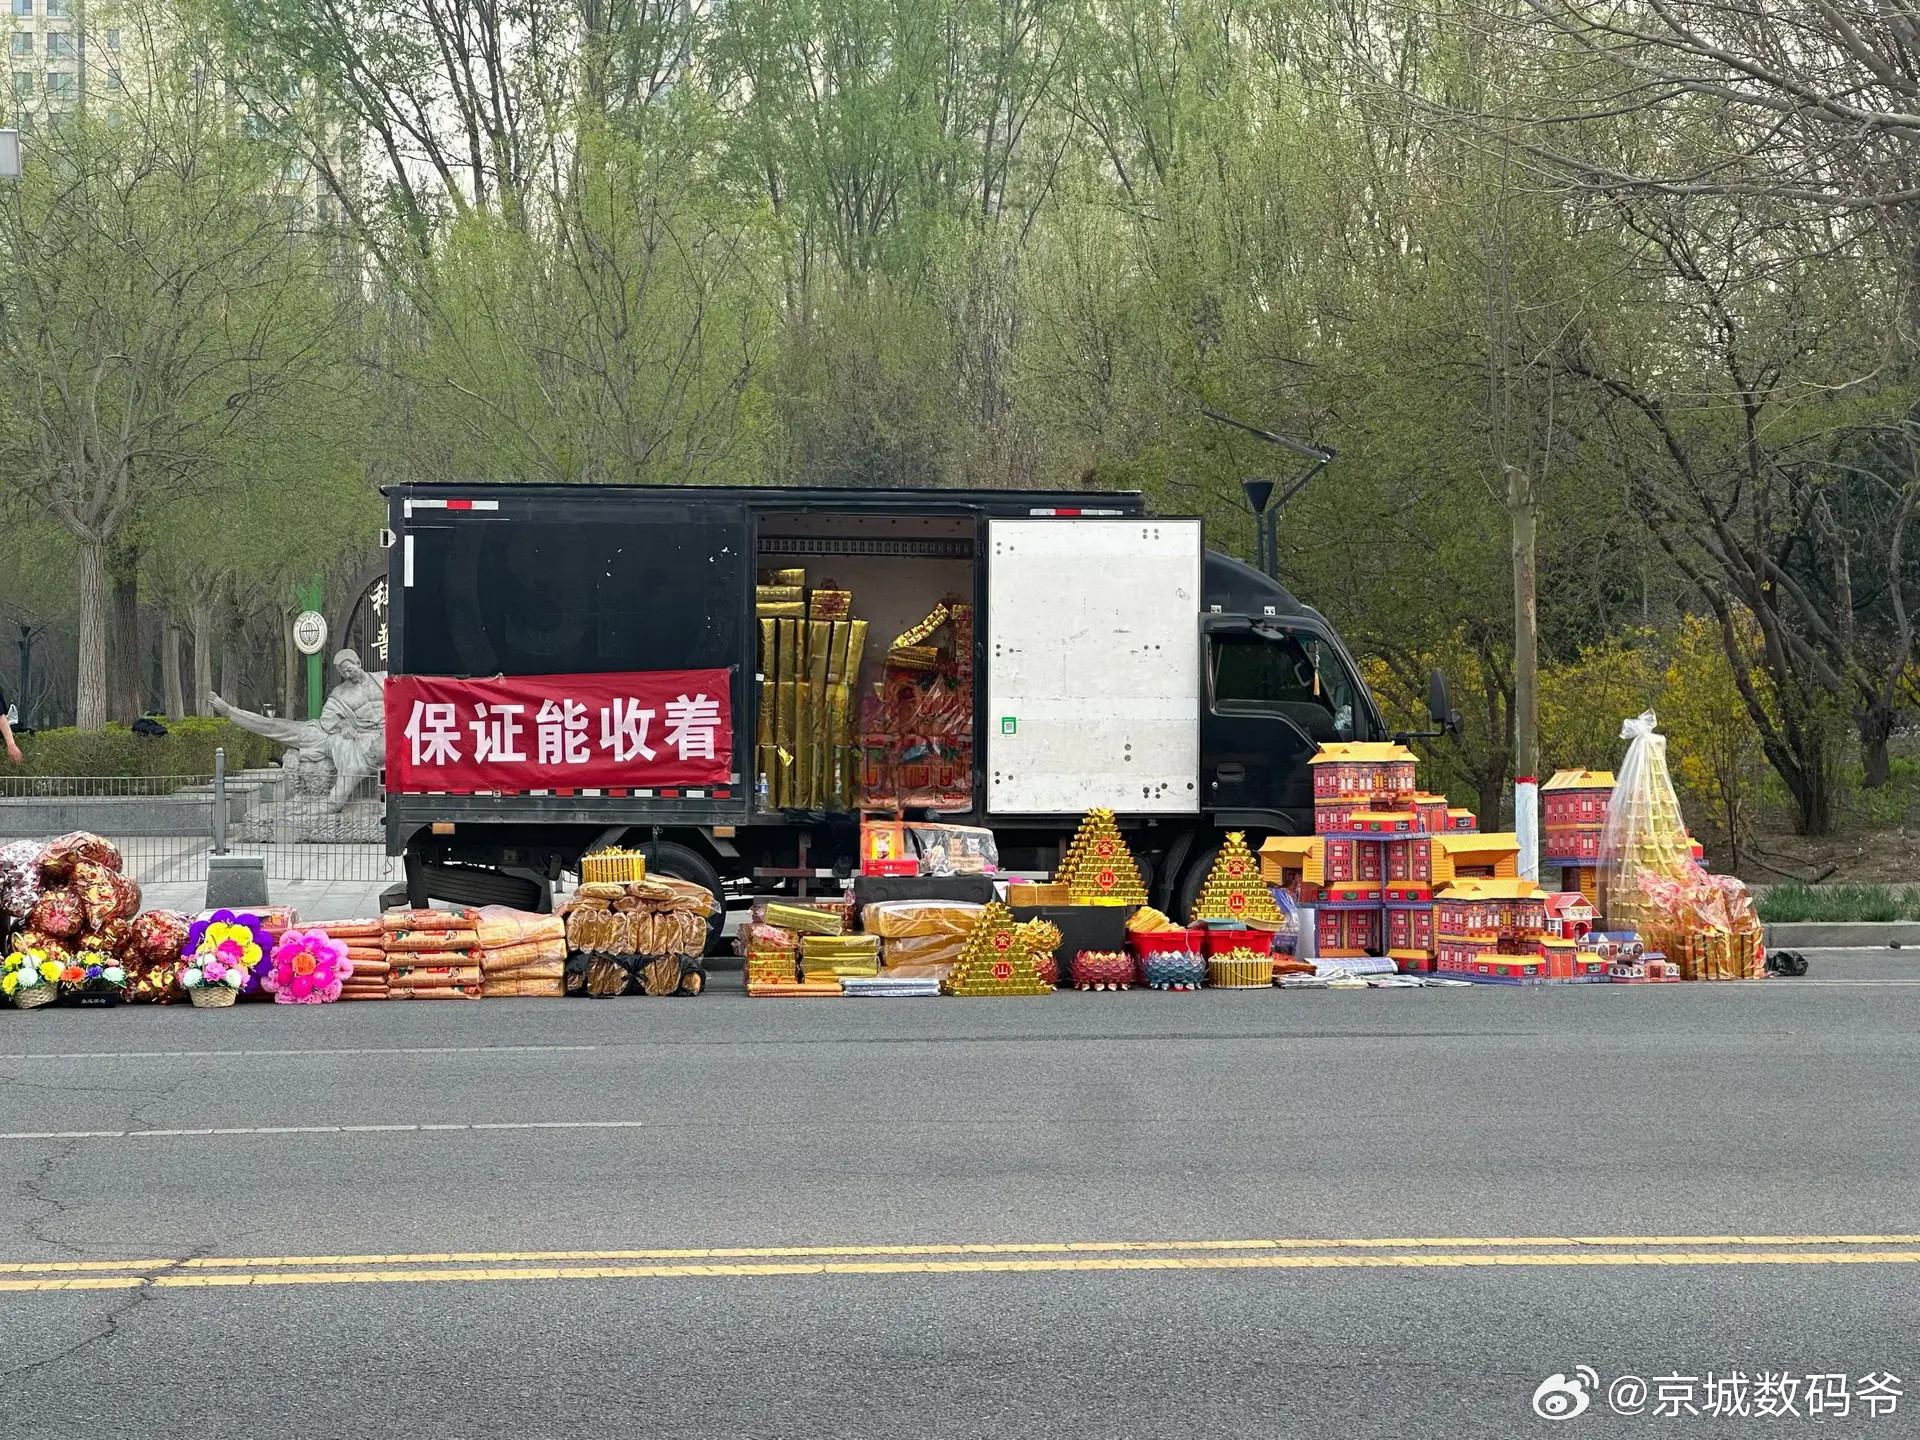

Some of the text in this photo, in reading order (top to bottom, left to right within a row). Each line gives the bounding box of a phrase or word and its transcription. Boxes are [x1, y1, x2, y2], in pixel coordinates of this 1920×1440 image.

[404, 694, 722, 766] 保证能收着
